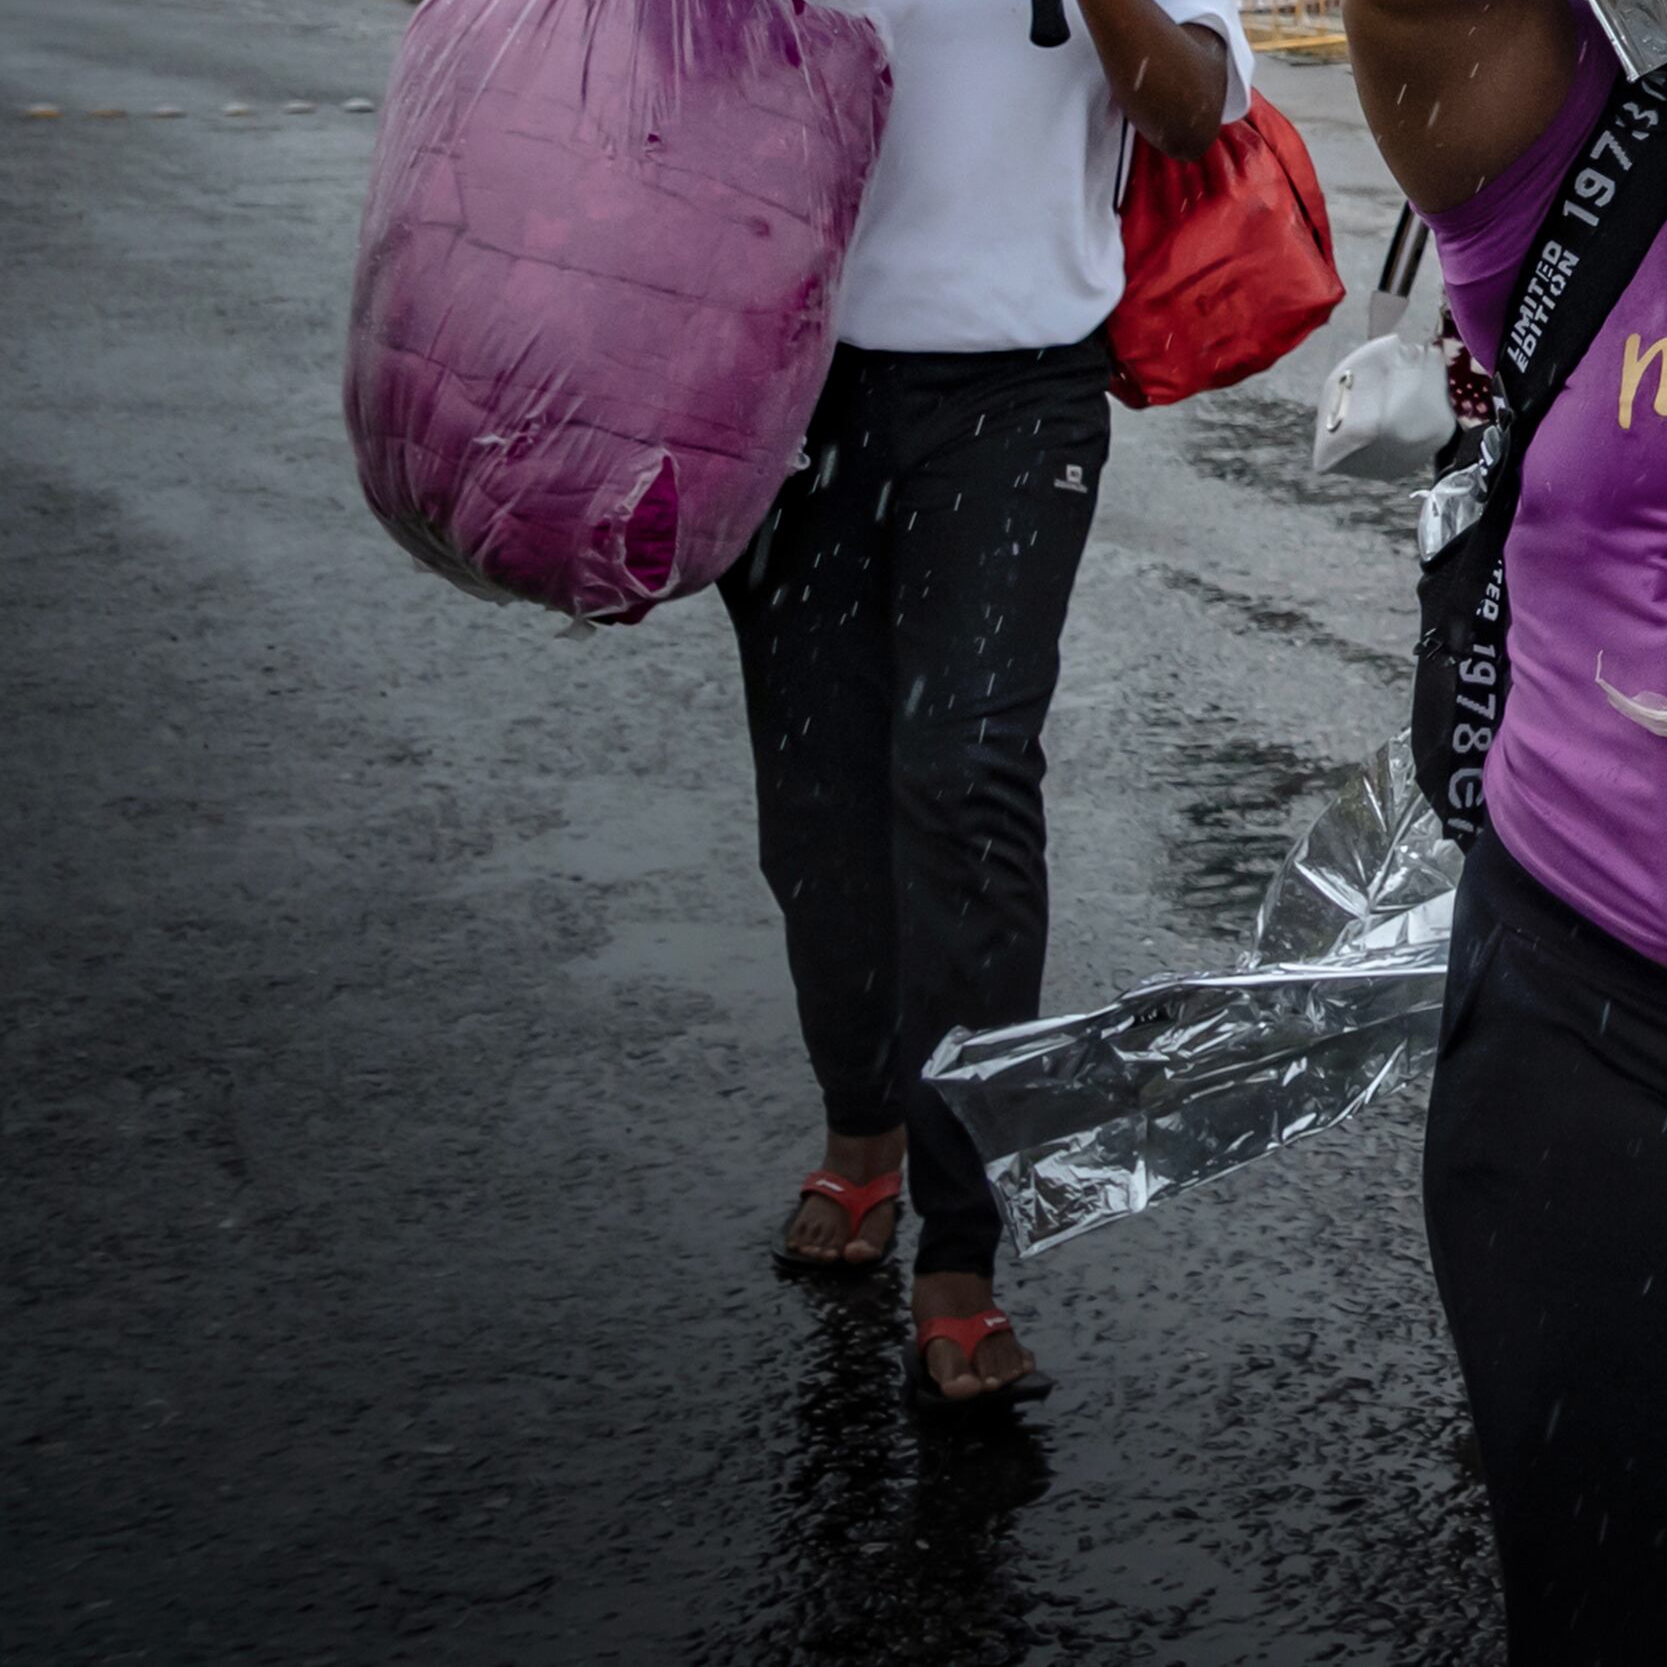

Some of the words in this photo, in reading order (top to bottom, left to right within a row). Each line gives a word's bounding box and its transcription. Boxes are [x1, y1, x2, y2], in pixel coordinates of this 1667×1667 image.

[1507, 240, 1562, 362] LIMITED
[1515, 249, 1580, 374] EDITION
[1452, 643, 1497, 754] 1978
